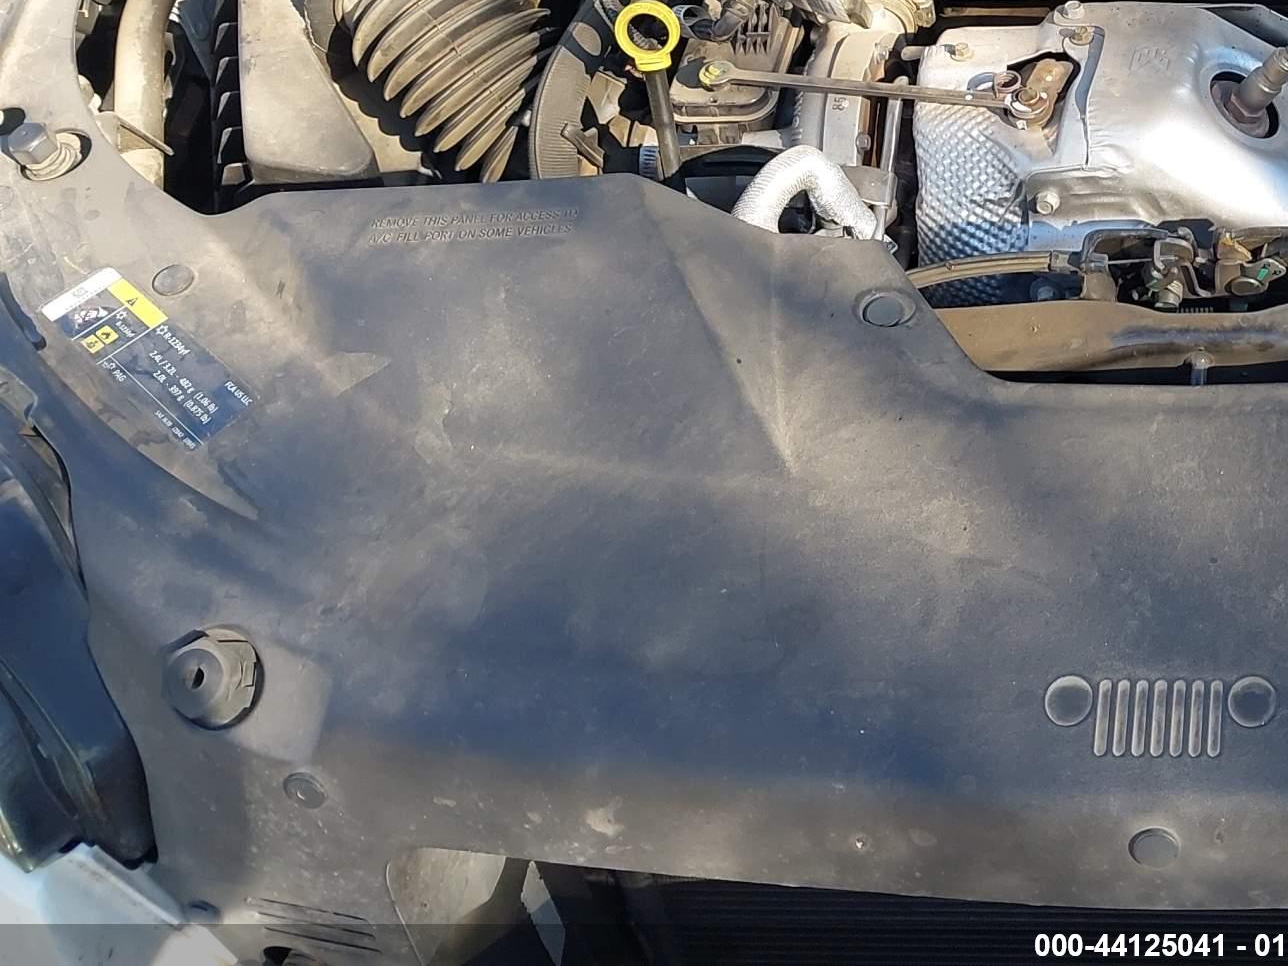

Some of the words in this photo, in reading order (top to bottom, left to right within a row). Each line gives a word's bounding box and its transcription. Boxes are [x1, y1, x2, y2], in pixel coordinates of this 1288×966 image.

[371, 216, 418, 228] REMOVE
[423, 215, 448, 226] THIS
[449, 213, 484, 225] PANEL
[489, 211, 514, 223] FOR
[515, 209, 559, 221] ACCESS
[368, 233, 391, 243] A/C
[395, 232, 420, 242] FILL
[424, 231, 452, 242] PORT
[457, 228, 475, 240] ON
[478, 227, 513, 239] SOME
[163, 332, 191, 356] R-1234yf
[113, 369, 127, 382] PAG
[224, 381, 238, 393] FCA
[240, 395, 253, 406] LLC
